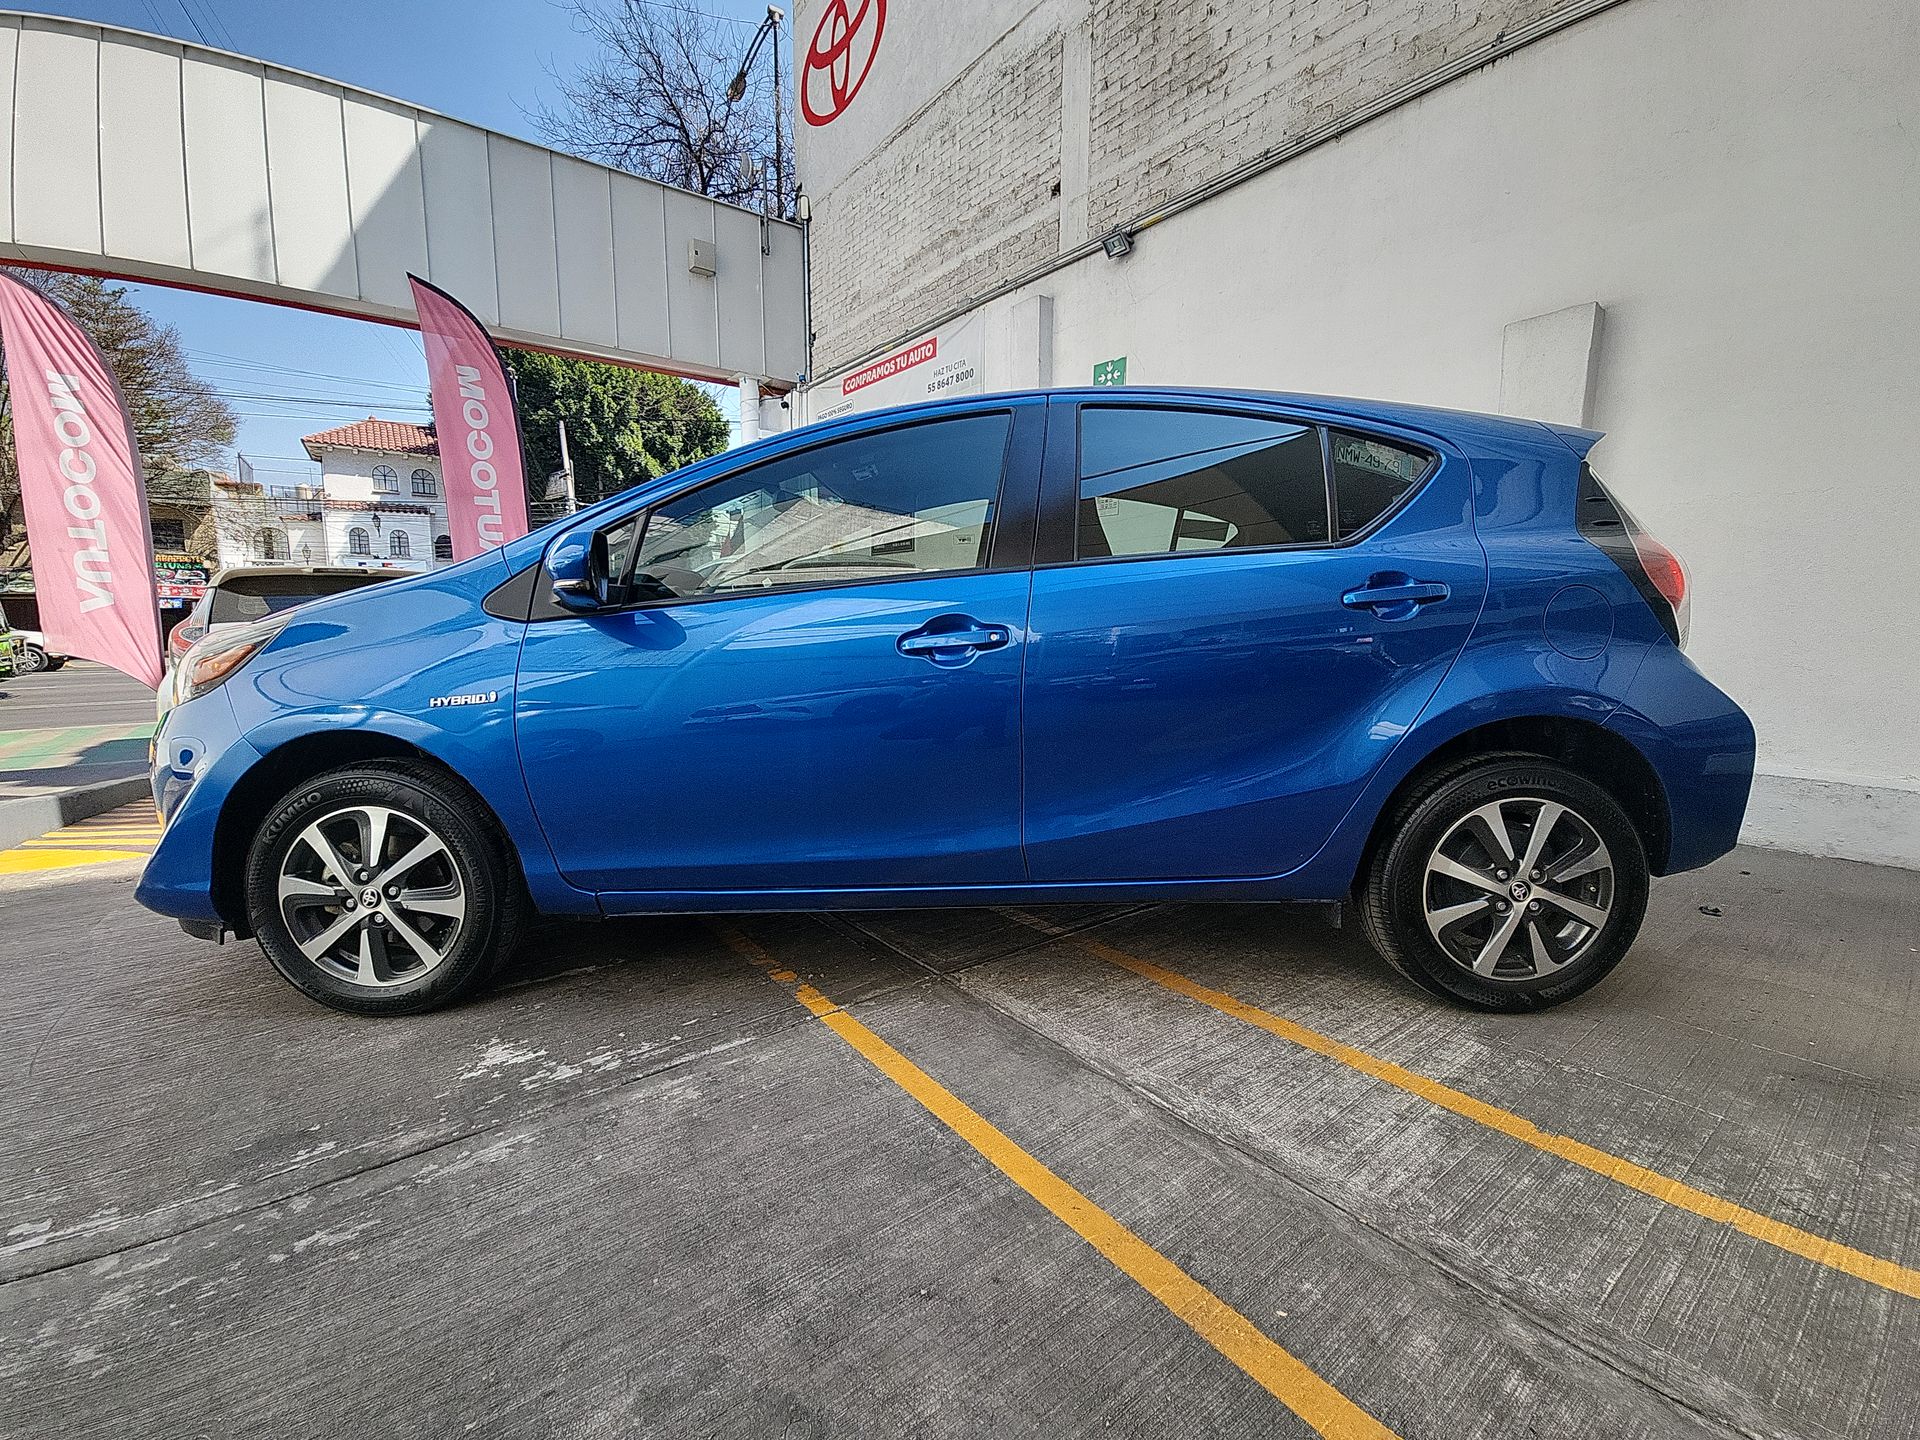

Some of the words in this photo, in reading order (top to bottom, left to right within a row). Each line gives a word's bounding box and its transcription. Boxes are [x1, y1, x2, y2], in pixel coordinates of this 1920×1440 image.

[844, 365, 895, 392] COMPRAMOS
[896, 356, 907, 370] TU
[908, 343, 933, 364] AUTO
[927, 382, 936, 394] 55
[955, 367, 975, 383] 8000
[933, 365, 945, 378] HAZ
[945, 363, 953, 375] TU
[953, 359, 967, 371] CITA
[429, 693, 487, 708] HYBRID
[262, 791, 322, 844] KUMHO
